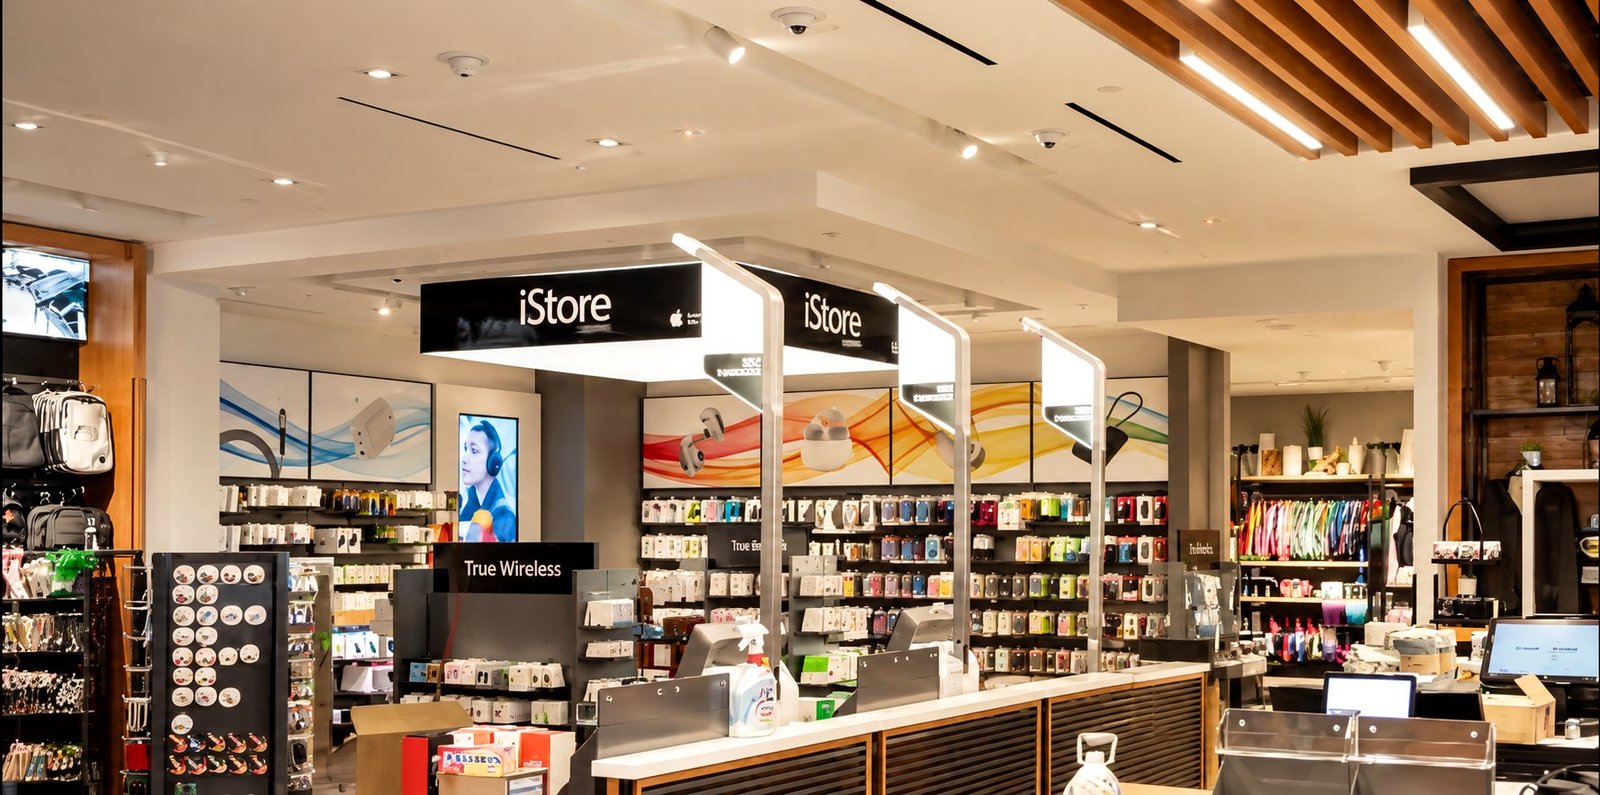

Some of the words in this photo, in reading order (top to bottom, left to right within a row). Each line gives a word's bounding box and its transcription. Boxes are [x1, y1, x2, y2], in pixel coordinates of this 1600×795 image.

[520, 288, 612, 325] iStore
[804, 292, 862, 337] iStore
[465, 560, 497, 577] True
[499, 560, 561, 577] Wireless
